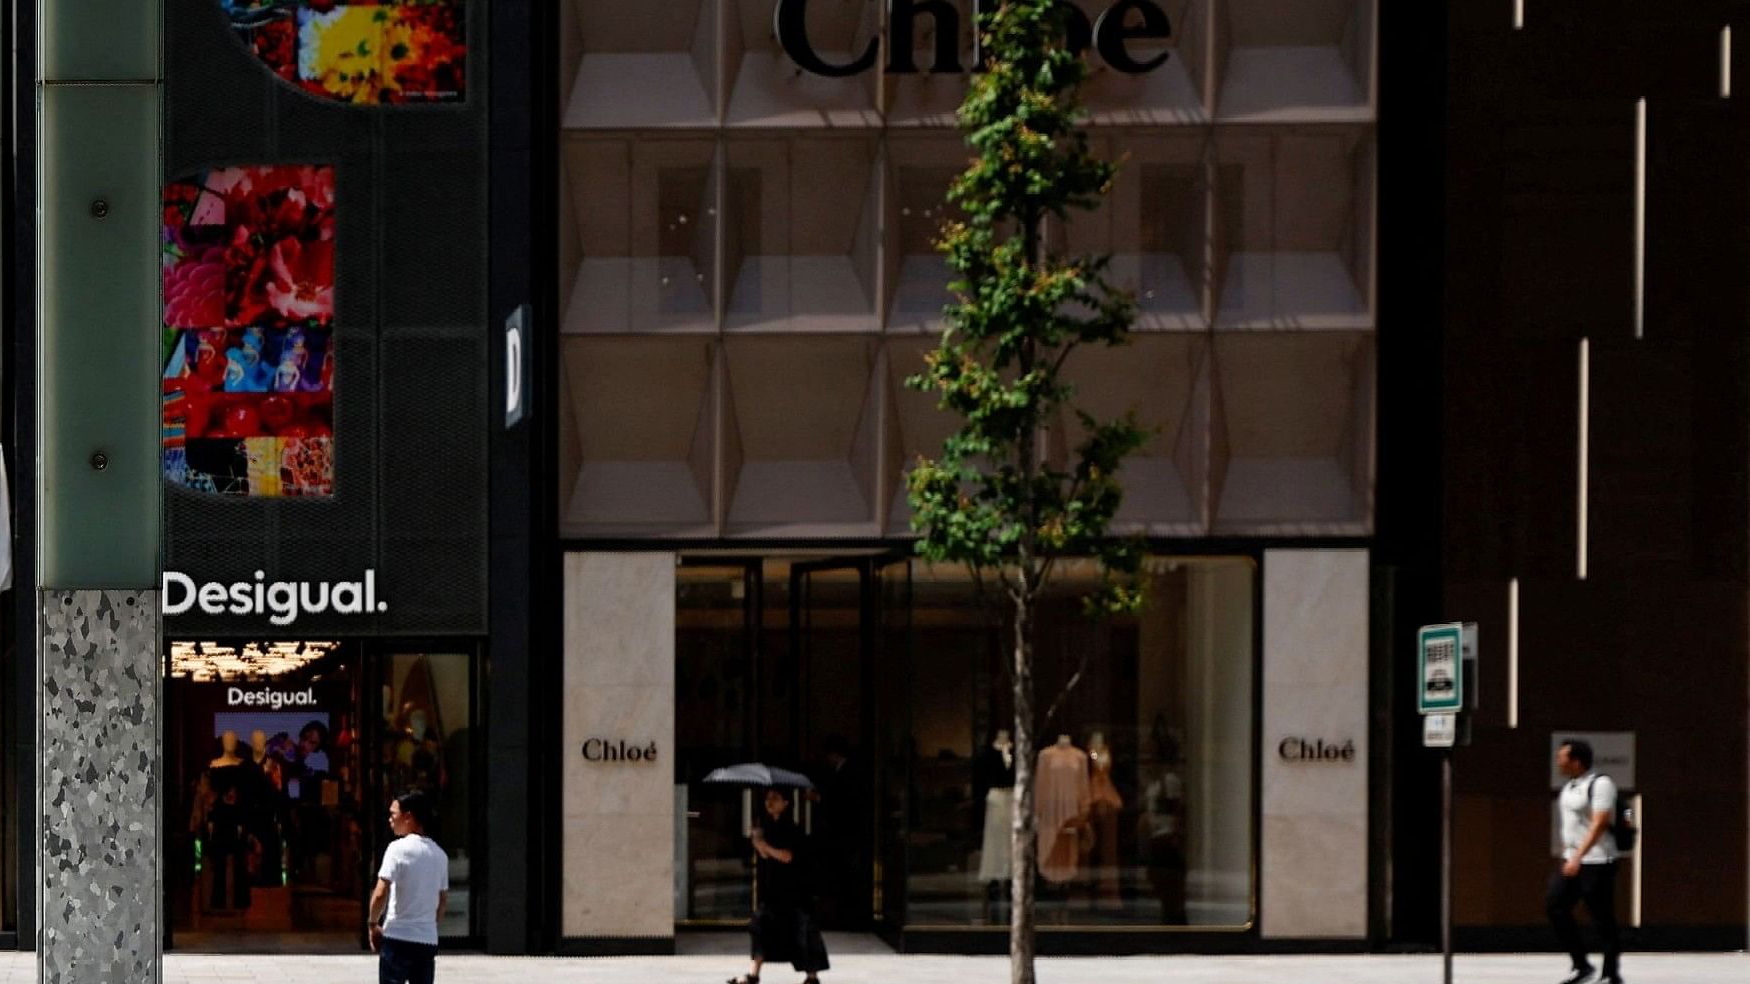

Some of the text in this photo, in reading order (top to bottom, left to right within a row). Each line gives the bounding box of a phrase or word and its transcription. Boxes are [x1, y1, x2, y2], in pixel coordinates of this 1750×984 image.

[162, 569, 388, 625] Desigual.
[227, 687, 317, 709] Desigual.
[582, 737, 657, 761] Chloé
[1278, 736, 1355, 761] Chloé
